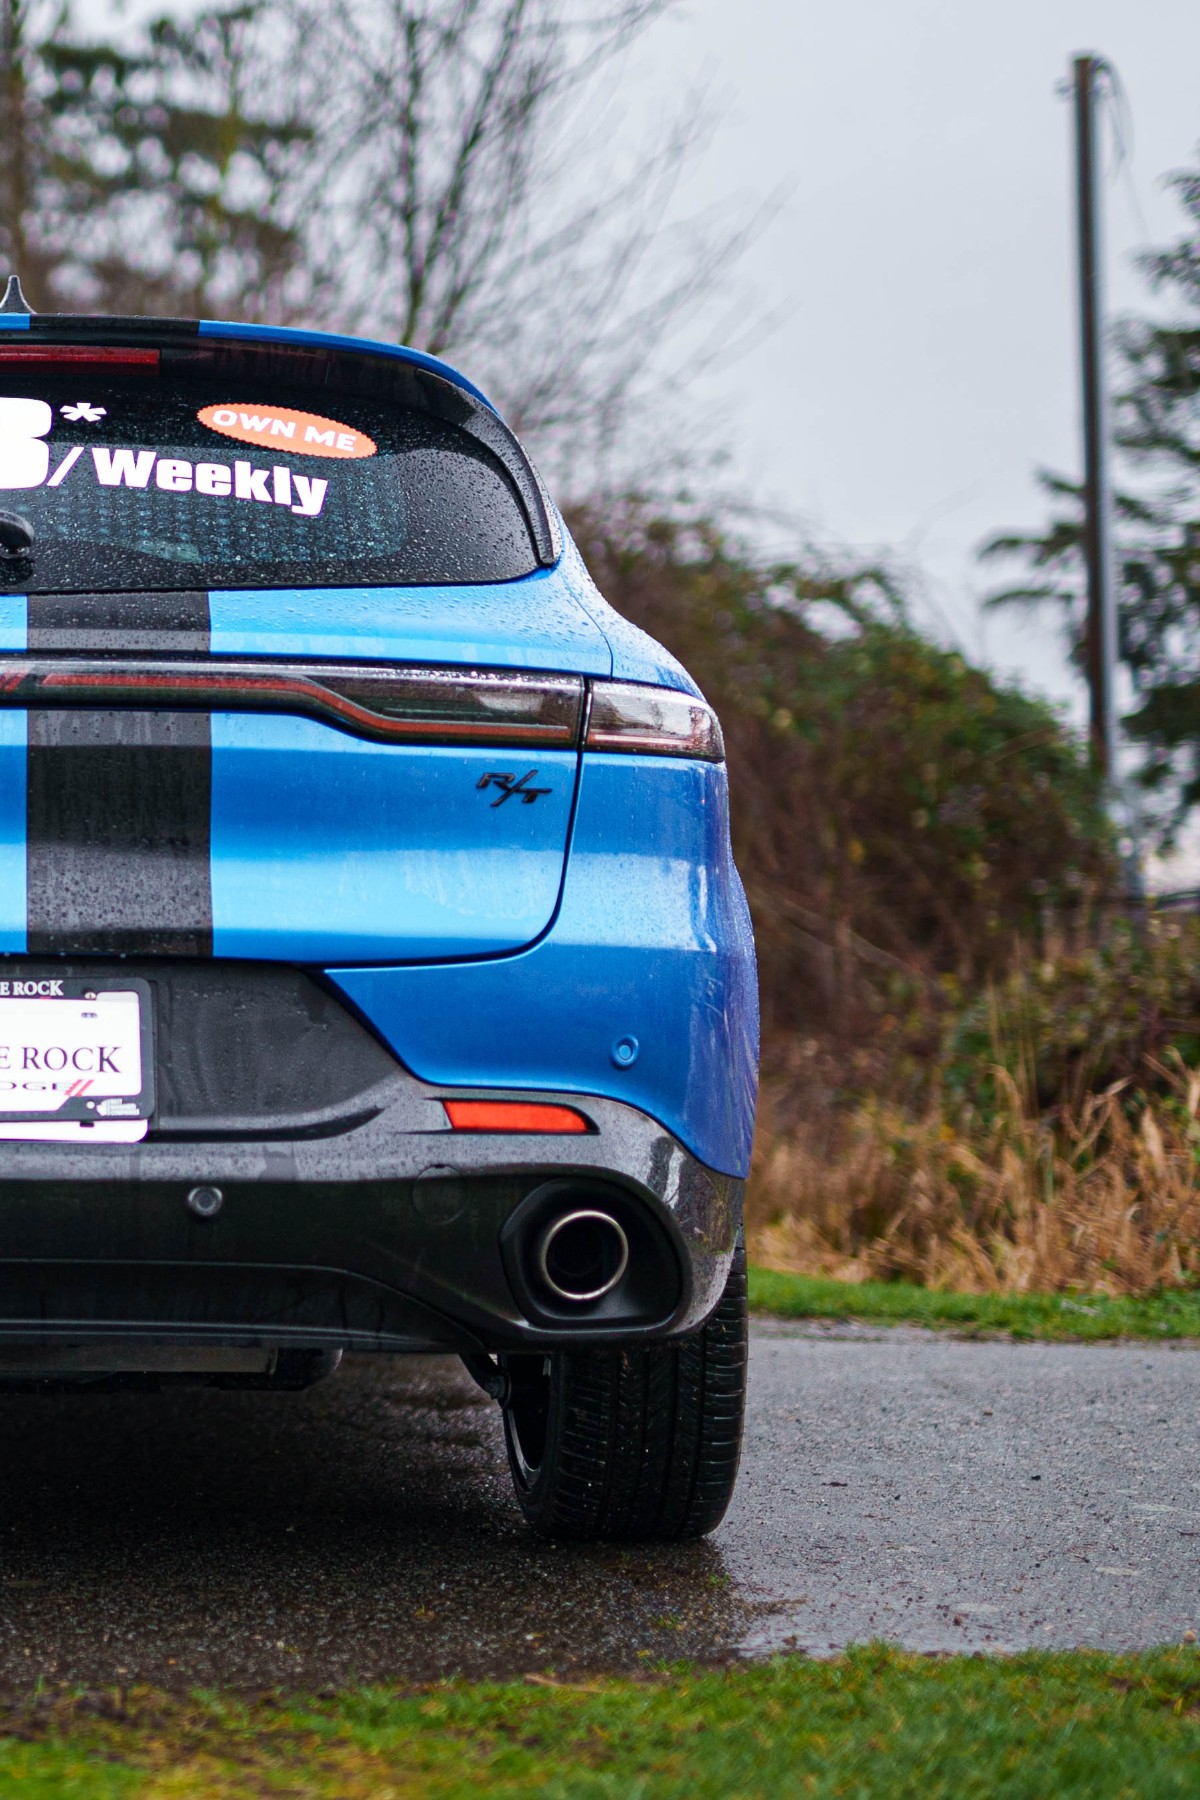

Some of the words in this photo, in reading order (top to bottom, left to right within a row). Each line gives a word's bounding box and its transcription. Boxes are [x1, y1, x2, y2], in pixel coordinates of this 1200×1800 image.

[212, 410, 296, 439] OWN
[303, 426, 358, 453] ME
[475, 769, 553, 808] R/T
[12, 979, 64, 997] ROCK
[21, 1045, 123, 1074] ROCK
